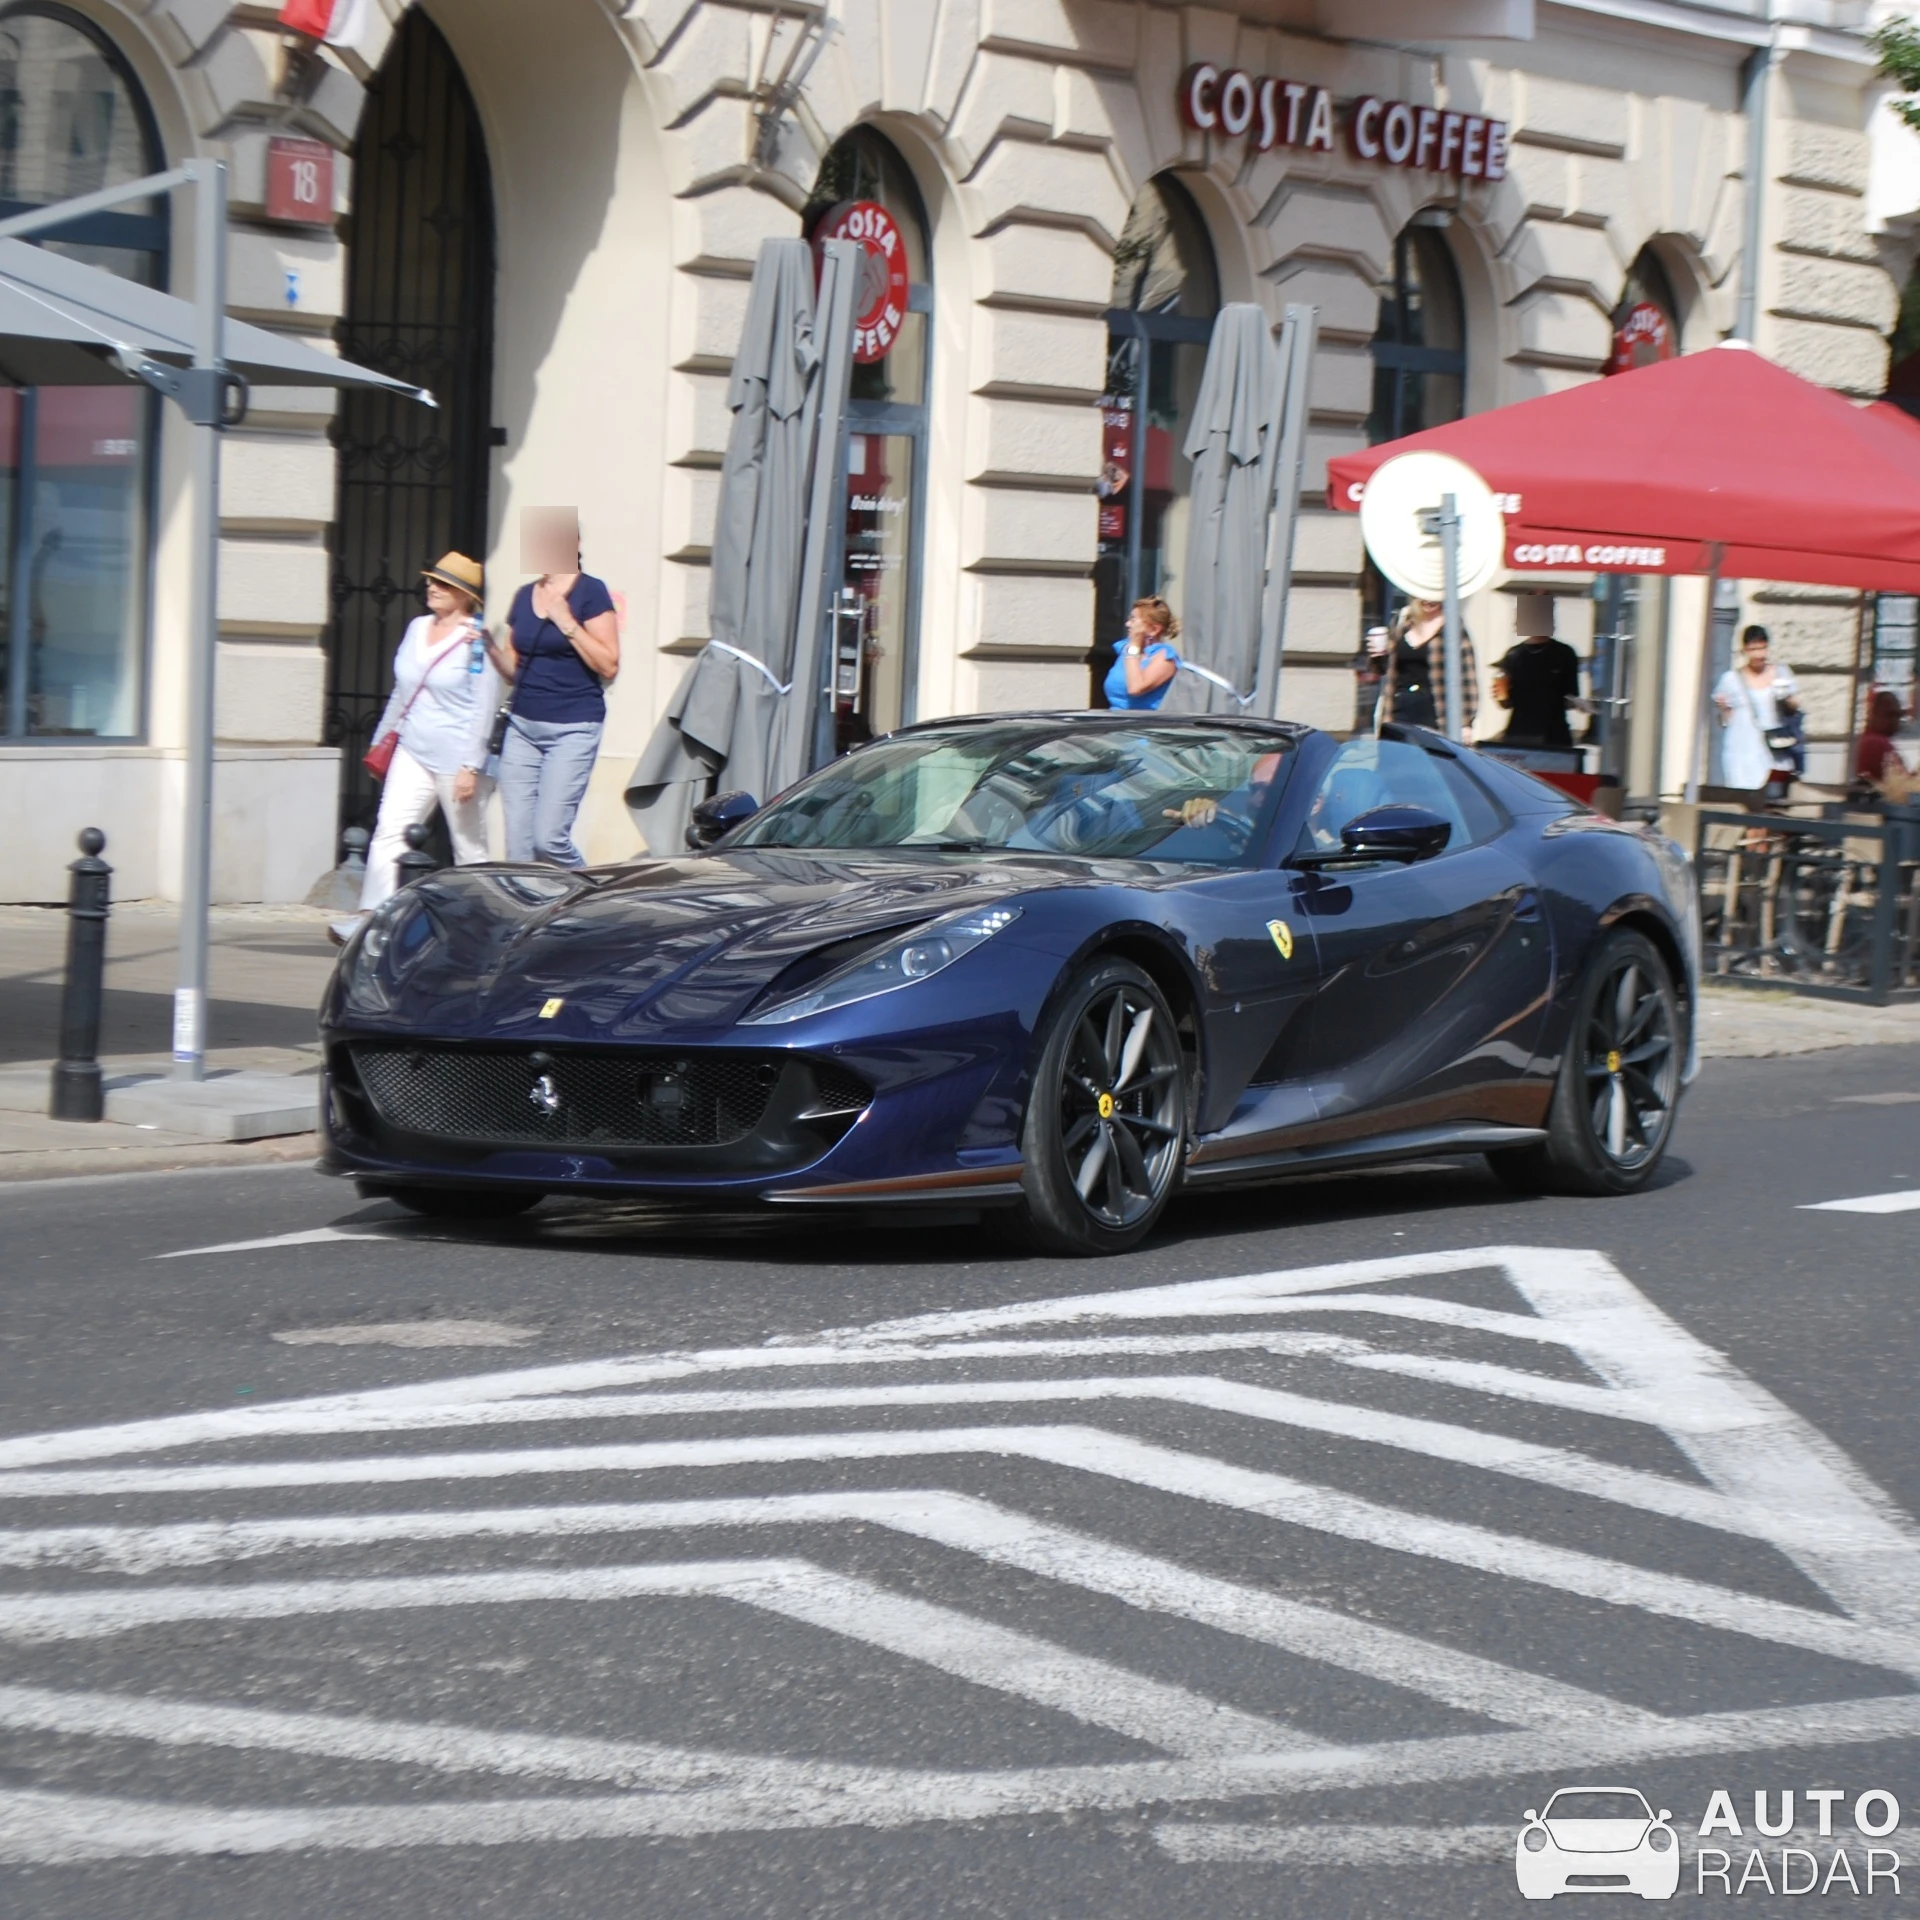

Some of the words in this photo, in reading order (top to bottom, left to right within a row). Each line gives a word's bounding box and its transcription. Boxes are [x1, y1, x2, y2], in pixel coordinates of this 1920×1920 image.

[1188, 64, 1334, 151] COSTA
[1355, 98, 1508, 180] COFFEE
[289, 160, 317, 204] 18
[853, 303, 900, 357] FFEE
[1513, 543, 1583, 565] COSTA
[1584, 544, 1667, 567] COFFEE
